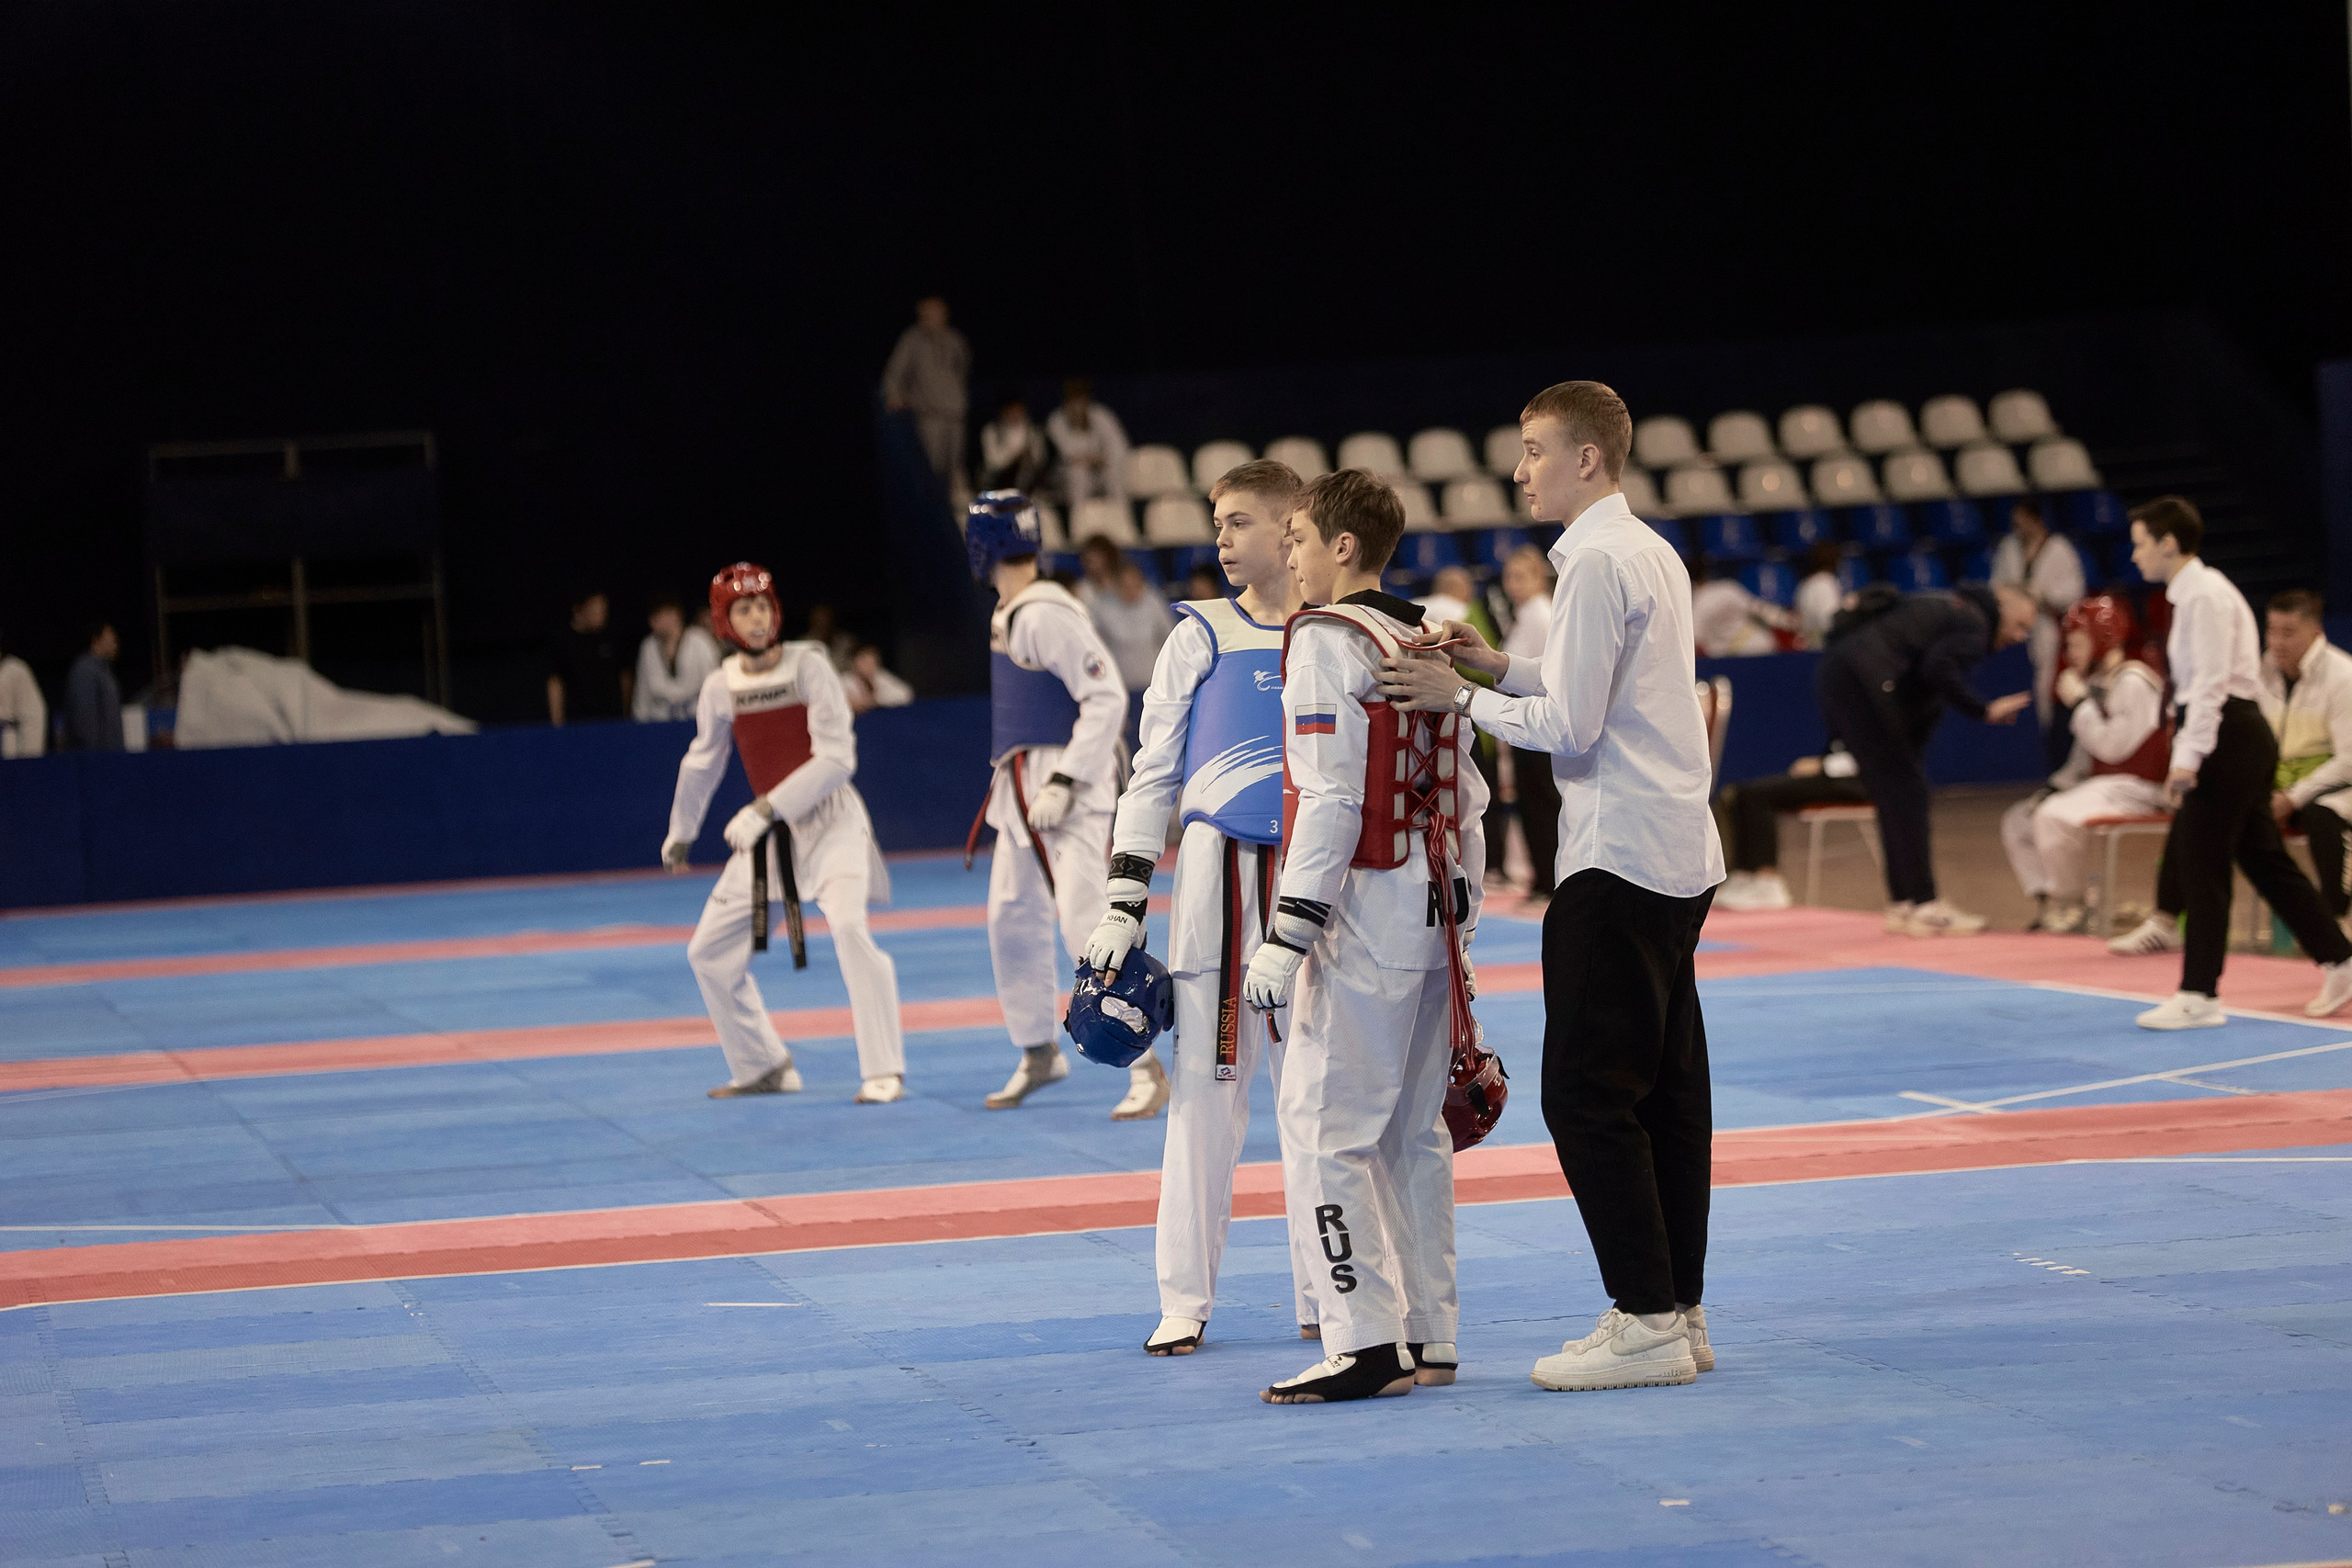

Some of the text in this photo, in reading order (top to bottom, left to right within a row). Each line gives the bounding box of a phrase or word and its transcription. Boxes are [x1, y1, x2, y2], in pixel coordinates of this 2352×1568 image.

[1270, 819, 1279, 834] 3
[1426, 876, 1472, 927] RU
[1107, 915, 1128, 924] KHAN
[1220, 997, 1237, 1055] RUSSIA
[1315, 1204, 1358, 1294] RUS
[1661, 1370, 1681, 1378] AIR
